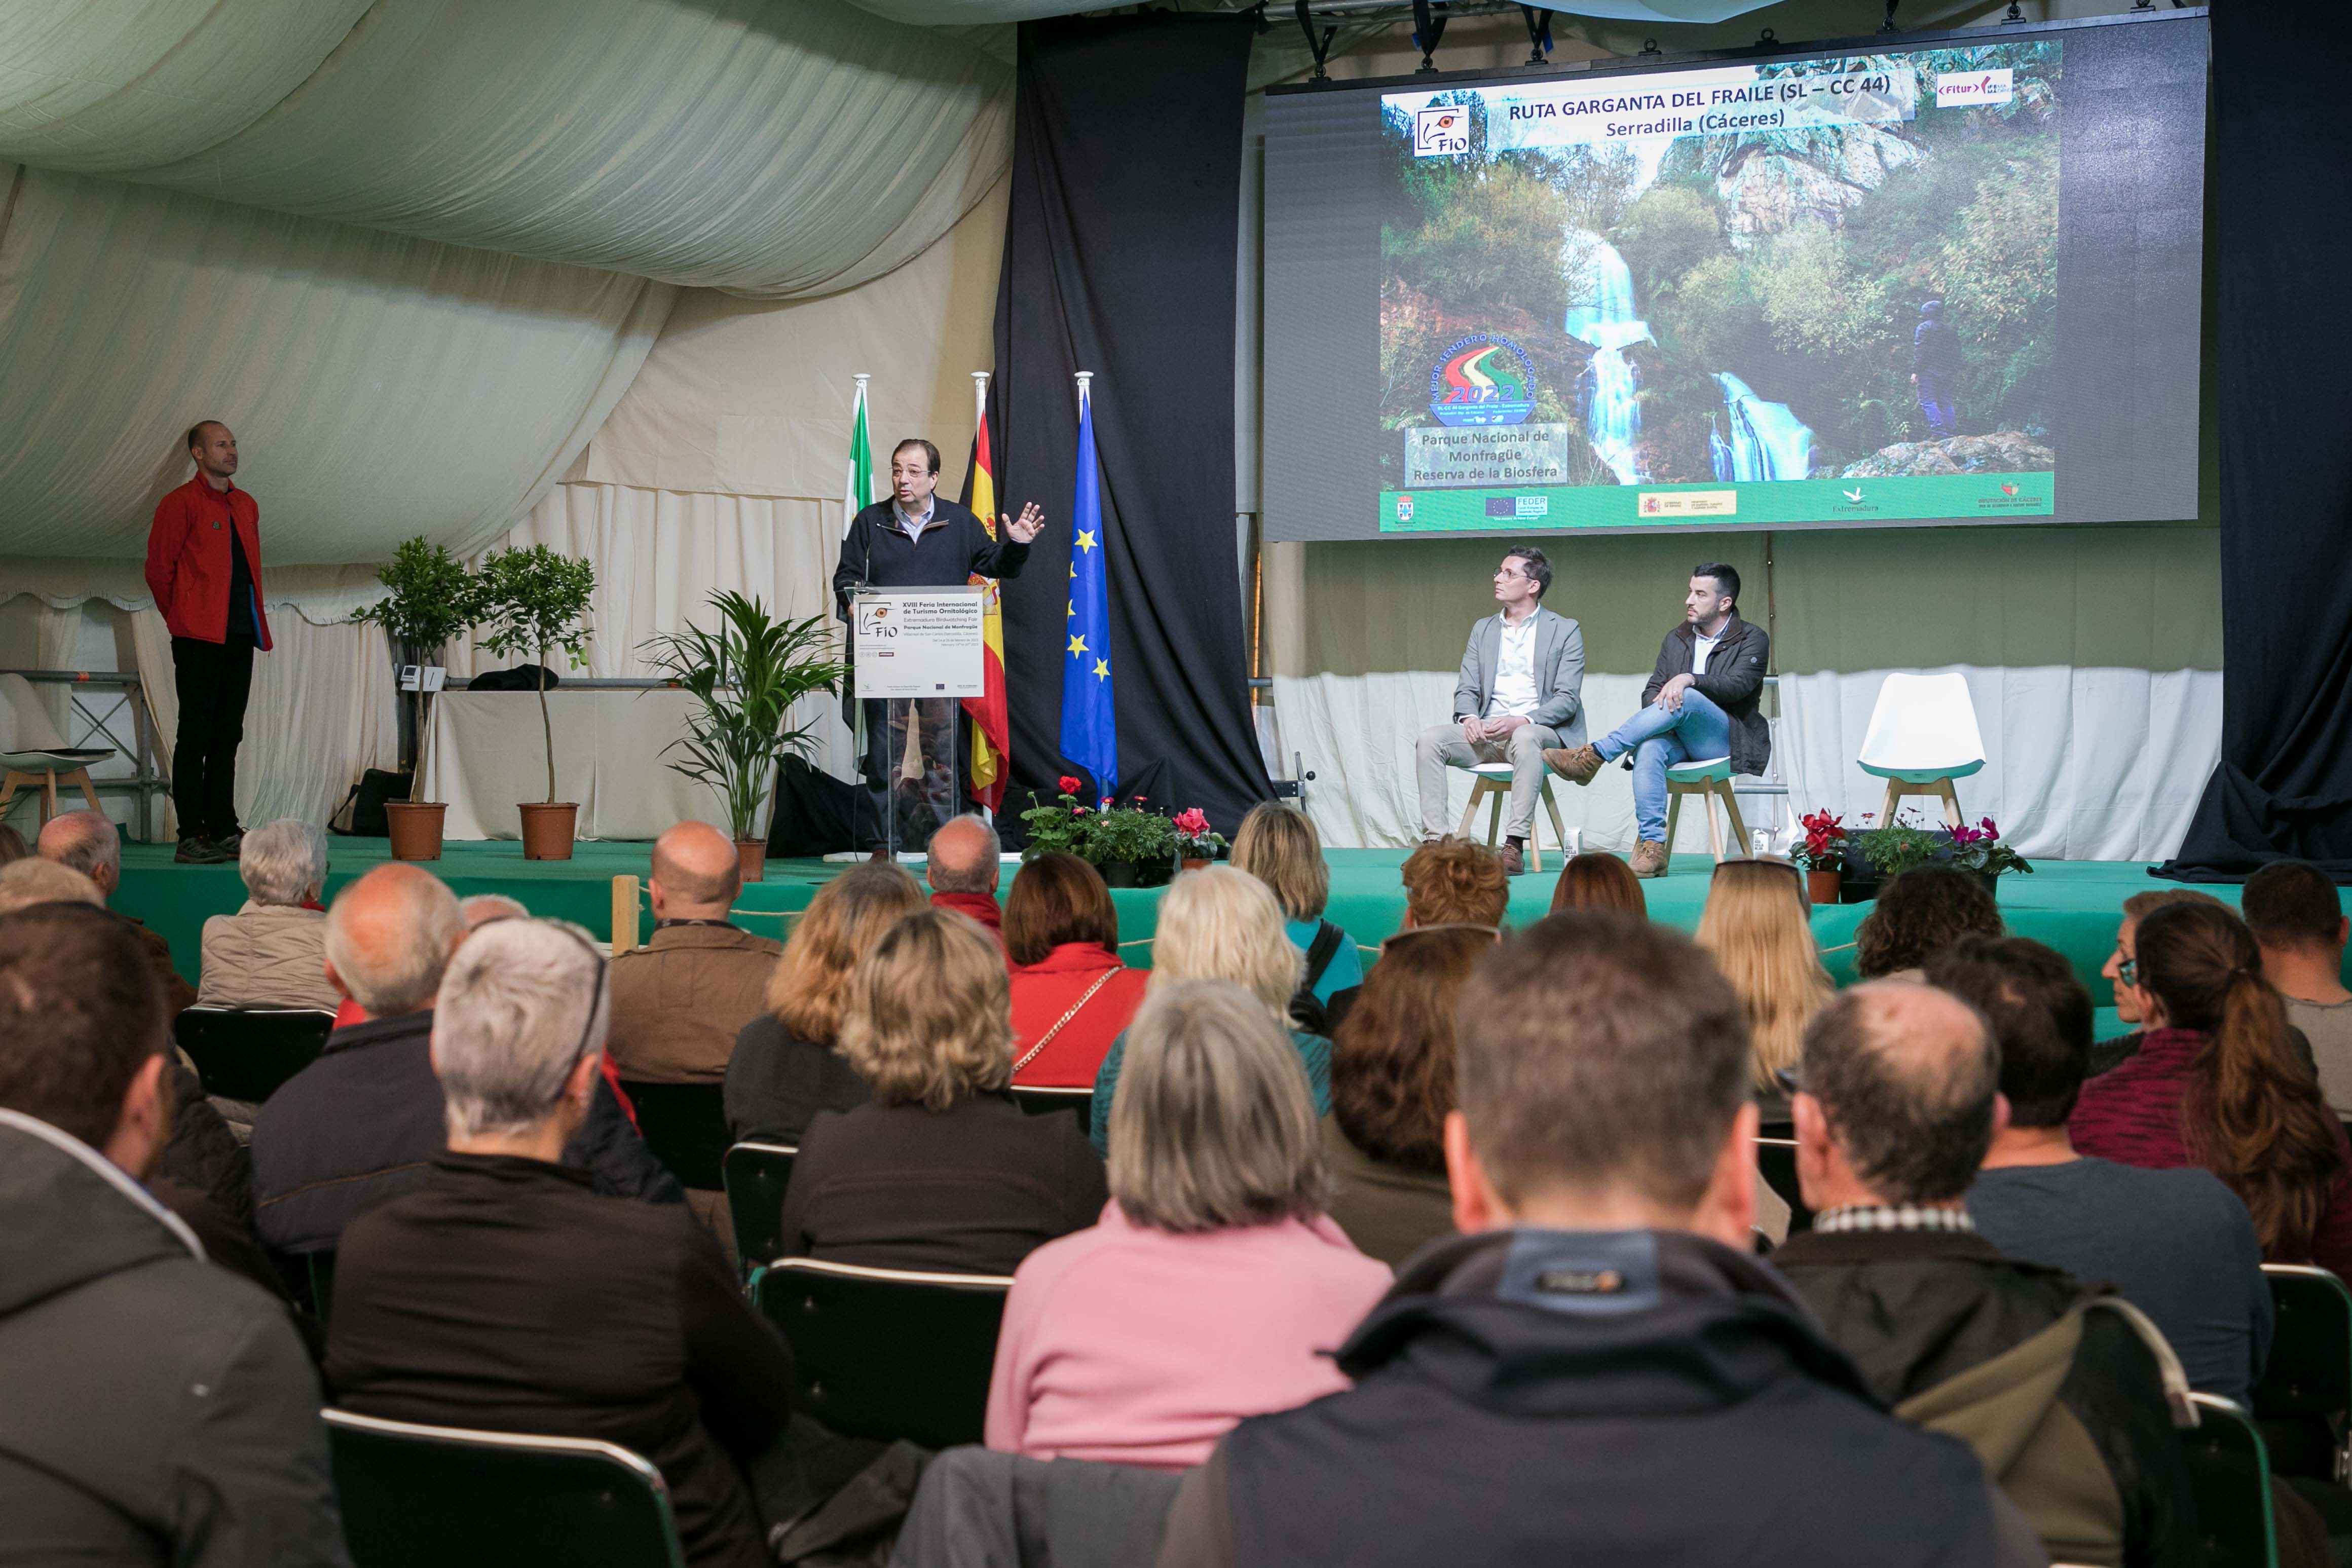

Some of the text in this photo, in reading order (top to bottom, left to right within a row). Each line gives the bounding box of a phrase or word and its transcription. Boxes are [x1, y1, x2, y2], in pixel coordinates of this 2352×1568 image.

[1510, 103, 1556, 120] RUTA
[1562, 95, 1665, 116] GARGANTA
[1672, 92, 1705, 107] DEL
[1712, 86, 1773, 104] FRAILE
[1780, 83, 1807, 102] (SL
[1831, 79, 1854, 95] CC
[1860, 75, 1890, 94] 44)
[1607, 108, 1784, 136] Serradilla (Cáceres)
[1430, 333, 1537, 401] MEJOR SENDERO HOMOLOGADO
[1450, 384, 1515, 403] 2022
[1422, 430, 1549, 446] Parque Nacional de
[1449, 449, 1522, 463] Monfragüe
[1413, 466, 1558, 481] Reserva de la Biosfera
